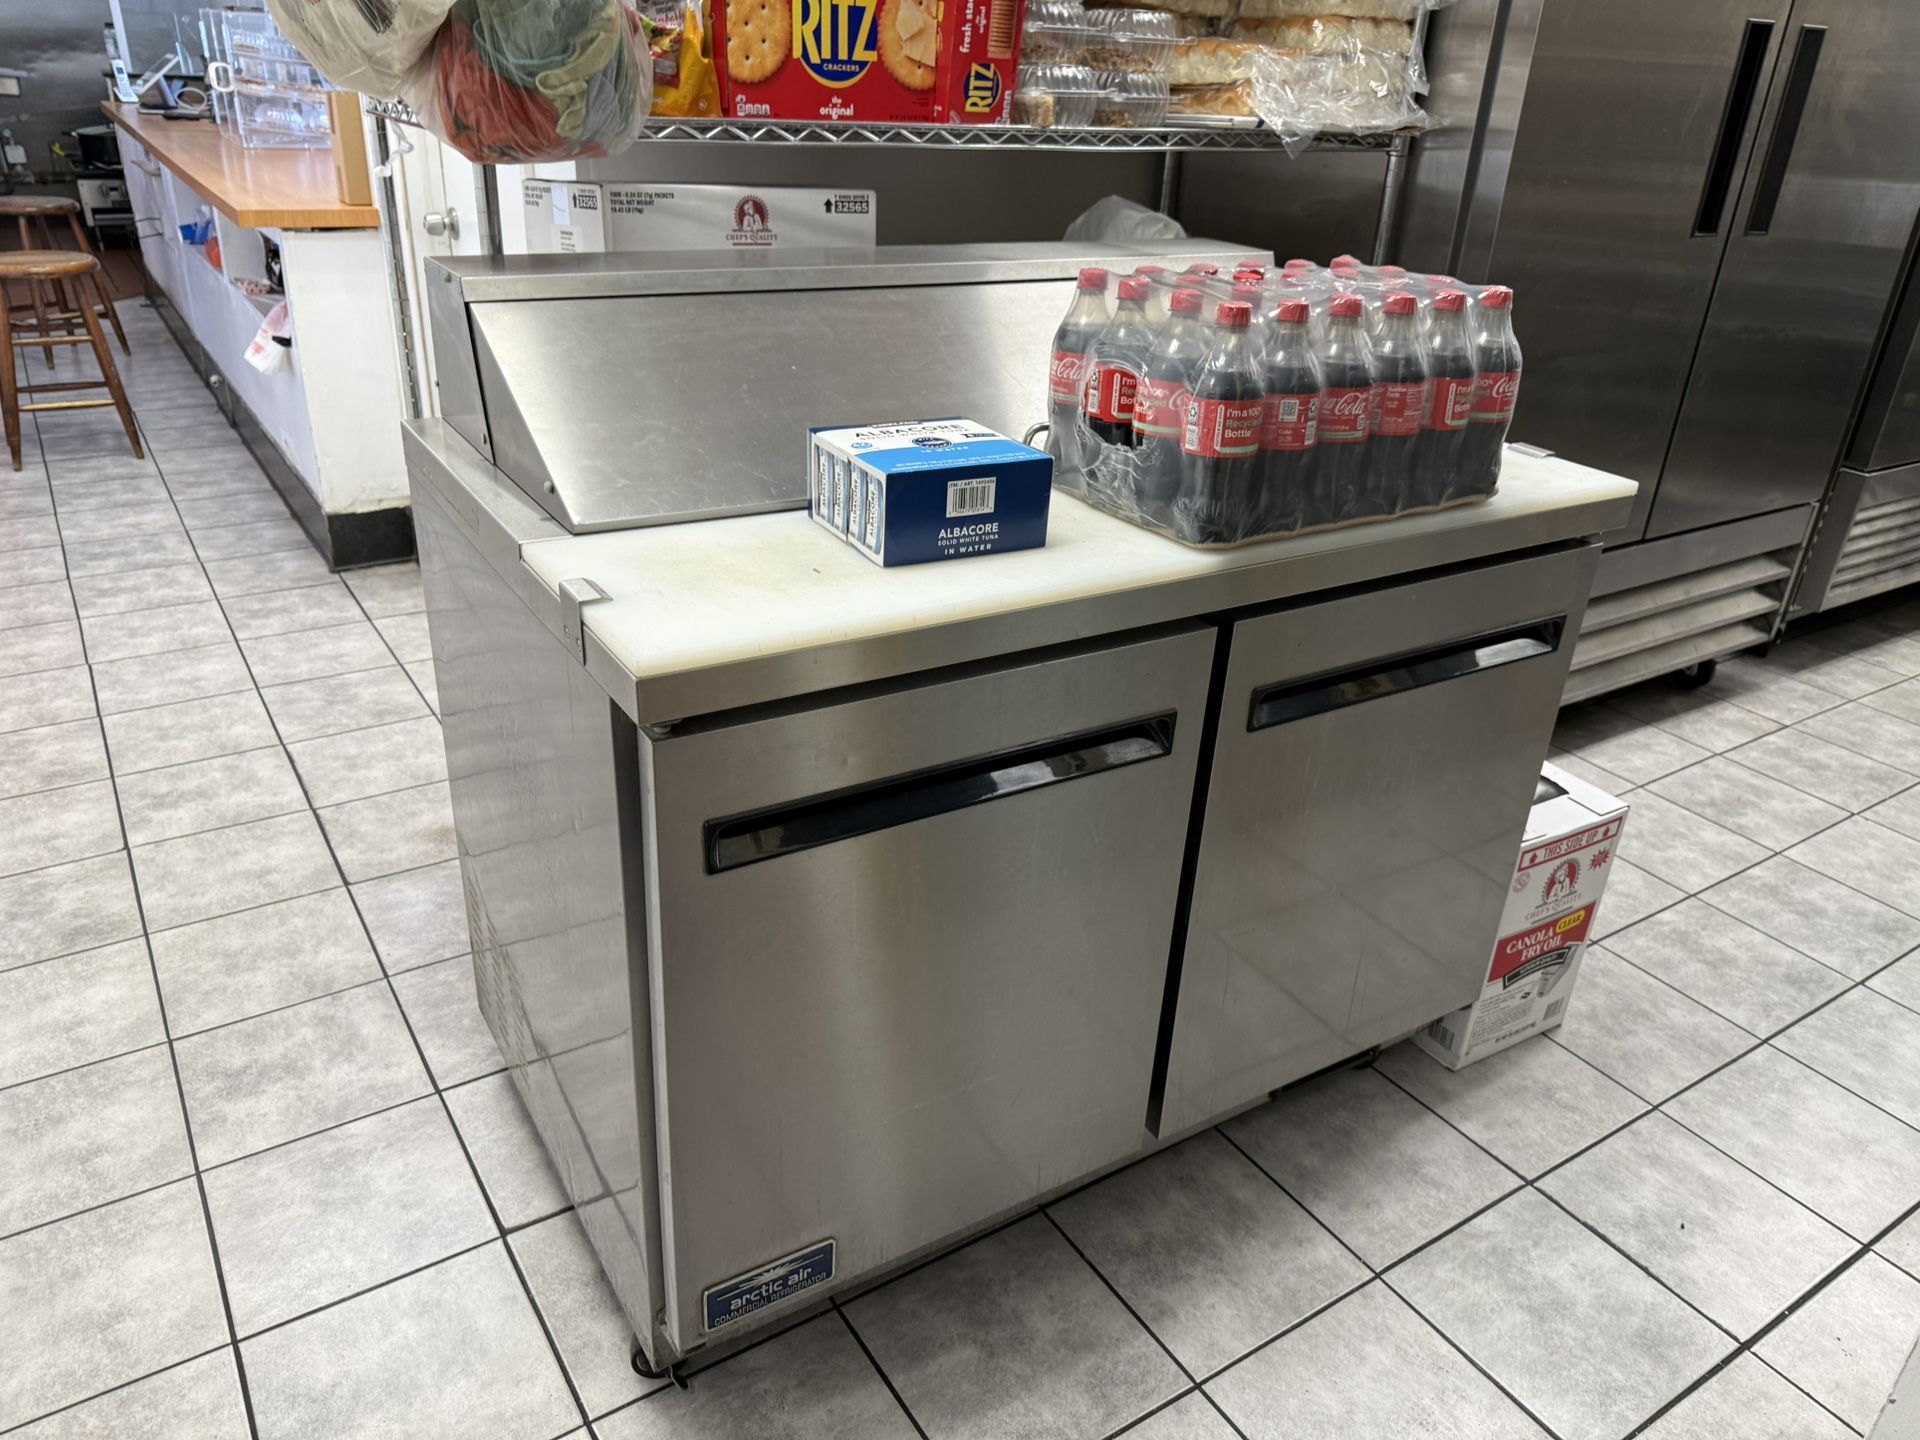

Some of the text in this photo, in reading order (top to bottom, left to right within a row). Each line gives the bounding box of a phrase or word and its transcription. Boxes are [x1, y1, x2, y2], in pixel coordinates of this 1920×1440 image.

[979, 6, 987, 34] original
[793, 0, 878, 64] RITZ
[959, 23, 973, 53] fresh
[823, 63, 860, 72] CRACKERS
[965, 62, 995, 113] RITZ
[819, 103, 854, 120] original
[836, 201, 869, 213] 32565
[750, 234, 778, 243] QUALITY
[1227, 408, 1241, 417] I'm
[856, 424, 964, 437] ALBACORE
[937, 533, 999, 547] SOLID WHITE TUNA
[938, 522, 999, 539] ALBACORE
[959, 543, 992, 553] WATER
[1543, 830, 1599, 858] THIS SIDE UP
[1524, 893, 1581, 920] CHEF'S QUALITY
[1558, 913, 1583, 930] CLEAR
[1506, 926, 1554, 954] CANOLA
[1521, 934, 1563, 961] FRY OIL
[714, 1272, 827, 1327] COMMERCIAL REFRIGERATOR
[730, 1267, 812, 1310] arctic air
